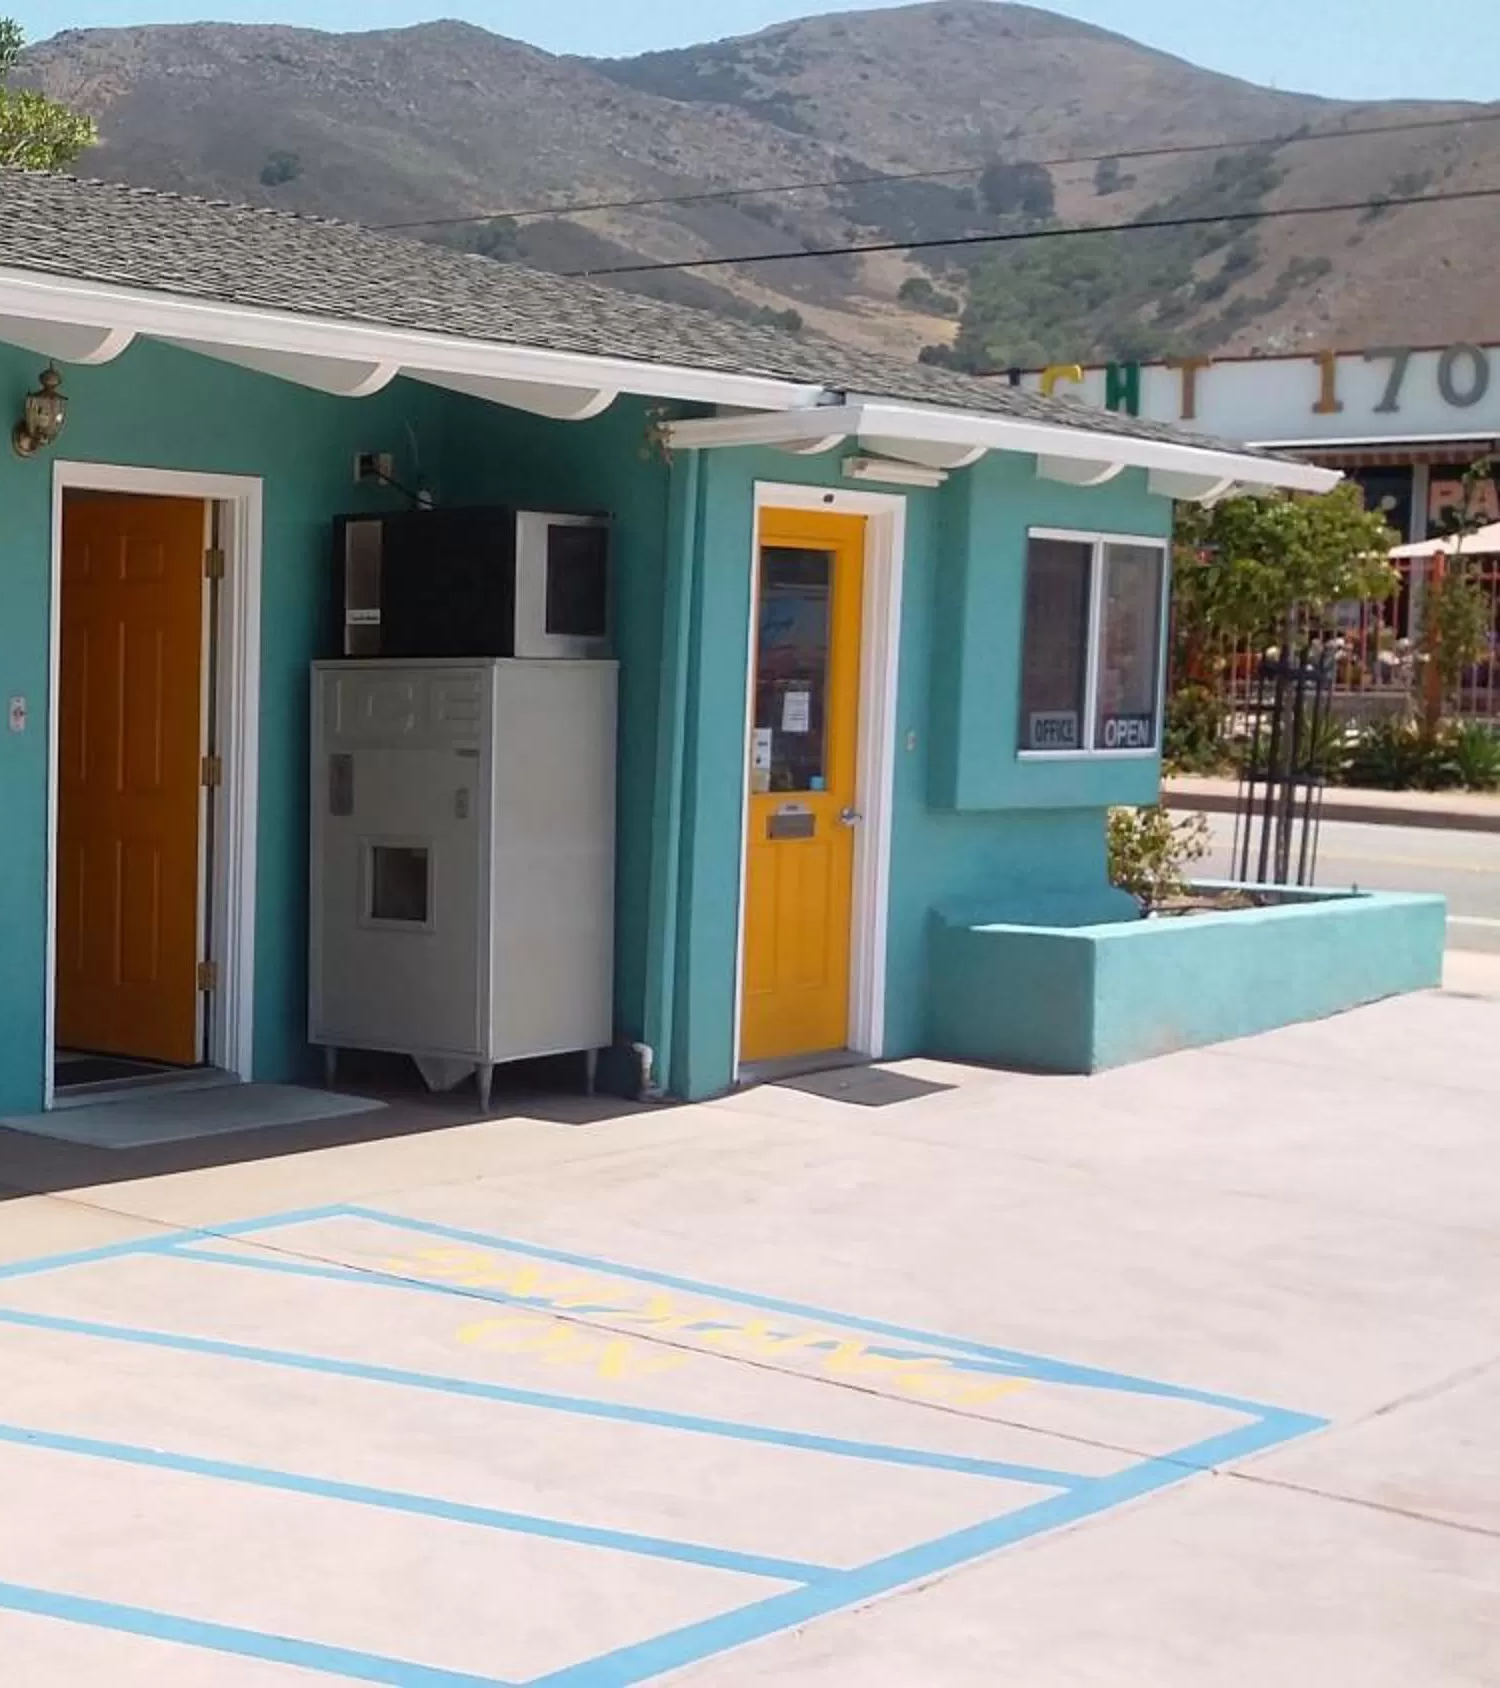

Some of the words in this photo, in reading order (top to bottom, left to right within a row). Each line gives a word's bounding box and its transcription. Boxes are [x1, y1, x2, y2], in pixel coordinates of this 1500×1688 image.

[1312, 341, 1491, 416] 170
[1035, 718, 1075, 743] OFFICE
[1104, 718, 1149, 746] OPEN
